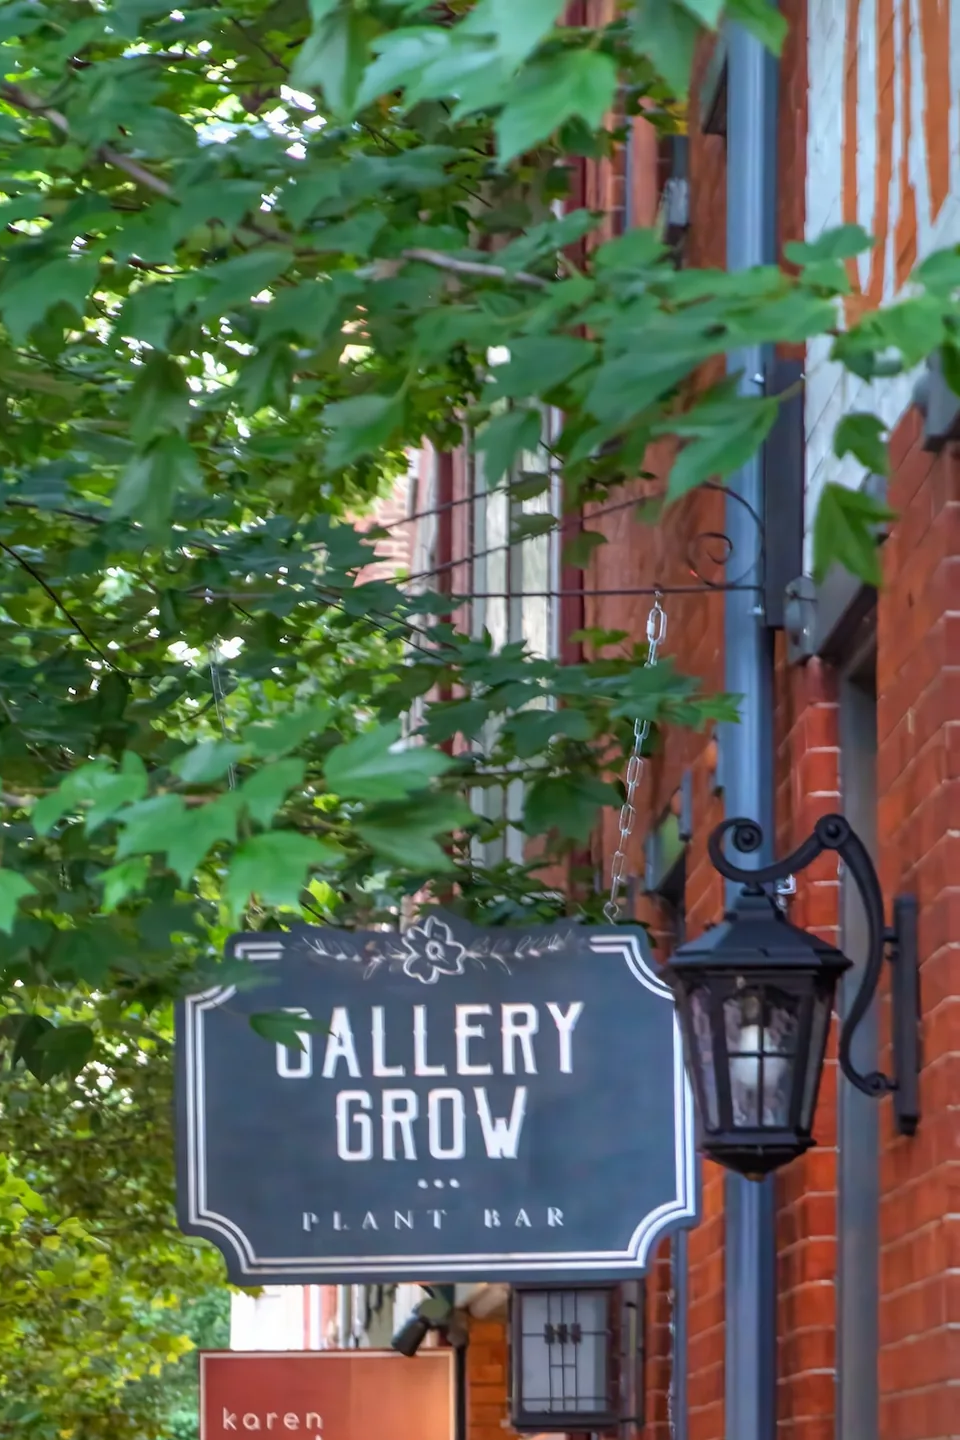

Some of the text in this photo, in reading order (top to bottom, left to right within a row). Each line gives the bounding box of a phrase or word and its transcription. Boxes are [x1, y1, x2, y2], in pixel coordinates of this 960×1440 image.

[275, 1002, 585, 1079] GALLERY
[335, 1086, 528, 1162] GROW
[302, 1206, 565, 1232] PLANT BAR
[223, 1407, 324, 1431] karen
